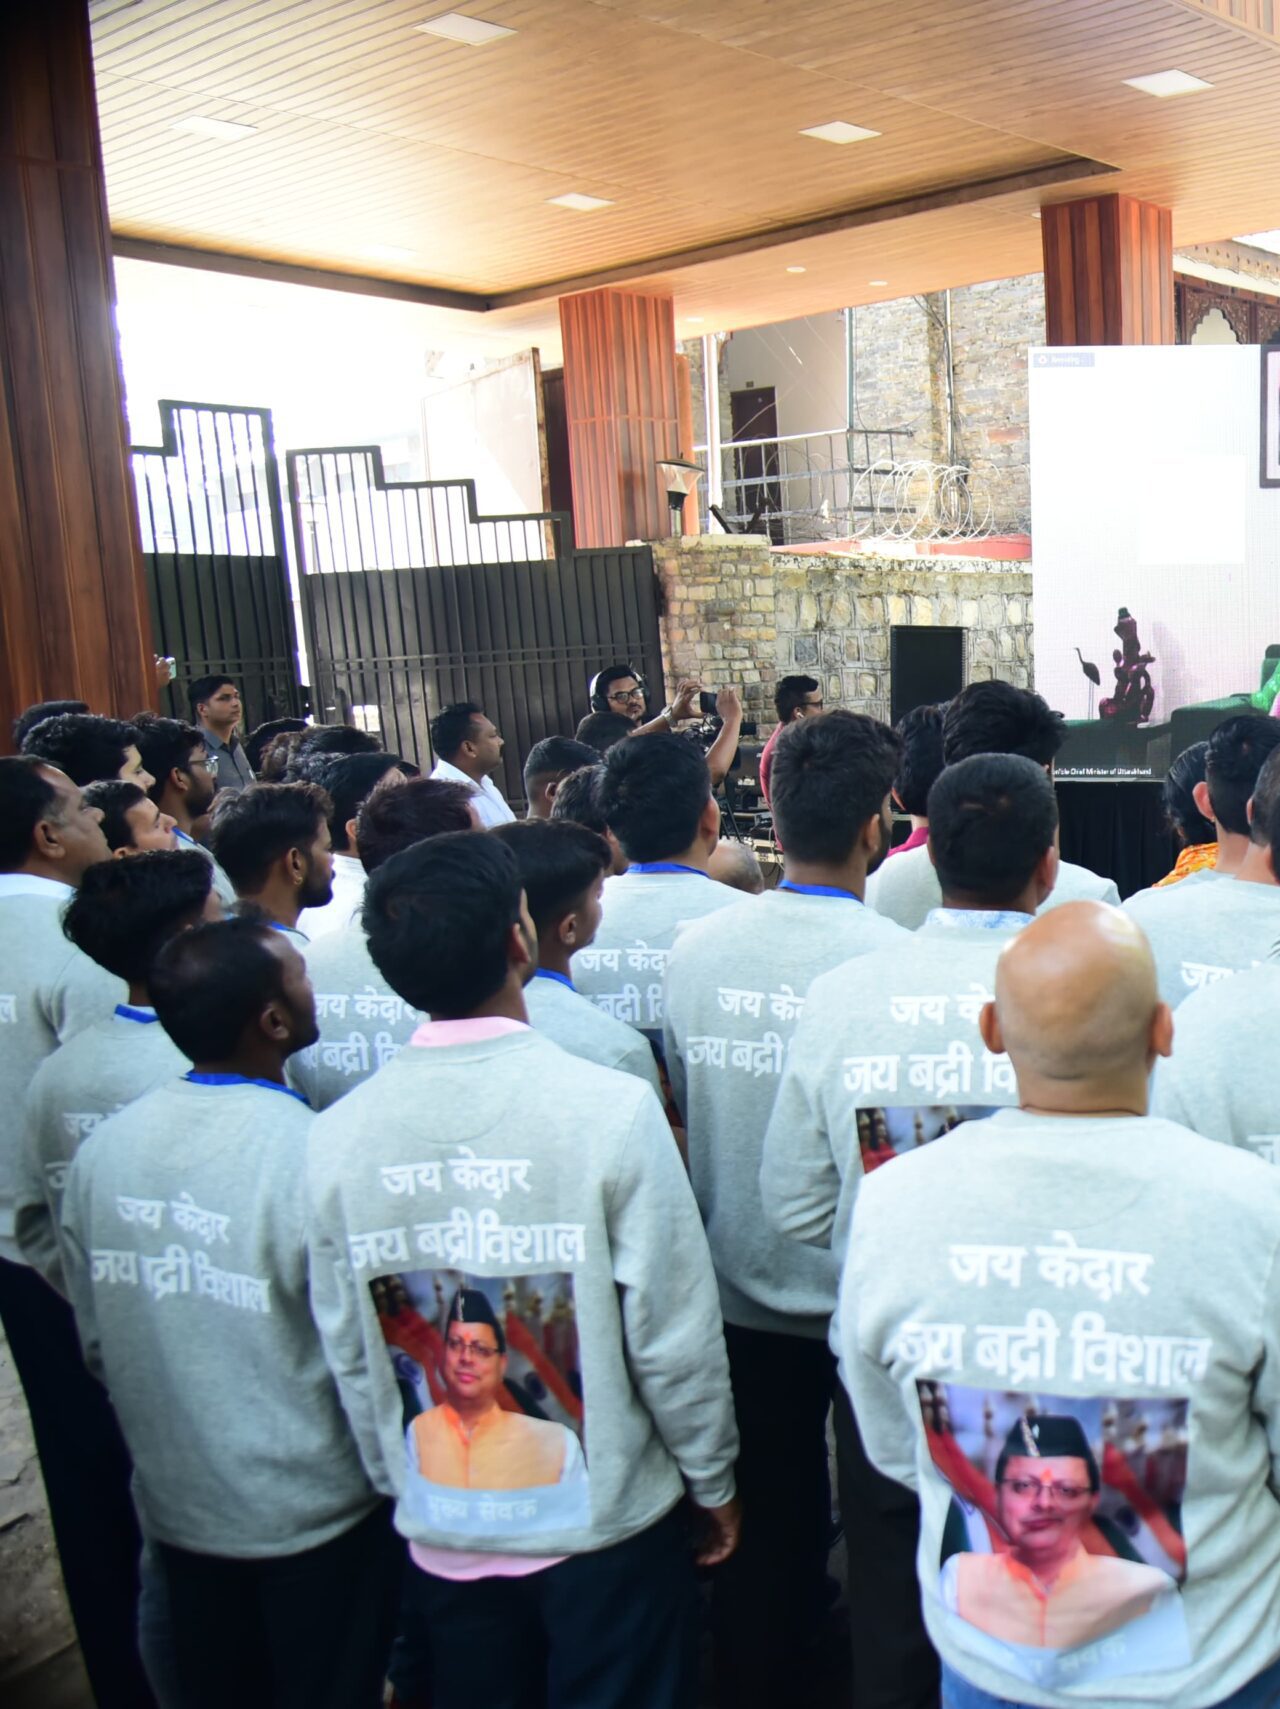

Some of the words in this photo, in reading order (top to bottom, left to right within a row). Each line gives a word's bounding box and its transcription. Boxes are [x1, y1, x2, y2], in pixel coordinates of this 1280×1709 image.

[580, 948, 622, 972] जय
[717, 986, 766, 1018] जय
[889, 995, 949, 1026] जय
[321, 1031, 370, 1076] बद्री
[686, 1035, 728, 1069] जय
[732, 1031, 784, 1077] बद्री
[842, 1054, 900, 1094] जय
[907, 1040, 974, 1099] बद्री
[380, 1159, 445, 1196] जय
[448, 1145, 533, 1200] केदार
[169, 1191, 230, 1245] केदार
[349, 1226, 410, 1269] जय
[413, 1205, 474, 1264] बद्री
[476, 1207, 586, 1264] विशाल
[91, 1248, 139, 1285] जय
[192, 1249, 271, 1313] विशाल
[948, 1243, 1028, 1288] जय
[1034, 1229, 1154, 1302] केदार
[973, 1307, 1060, 1385] बद्री
[1068, 1310, 1213, 1388] विशाल
